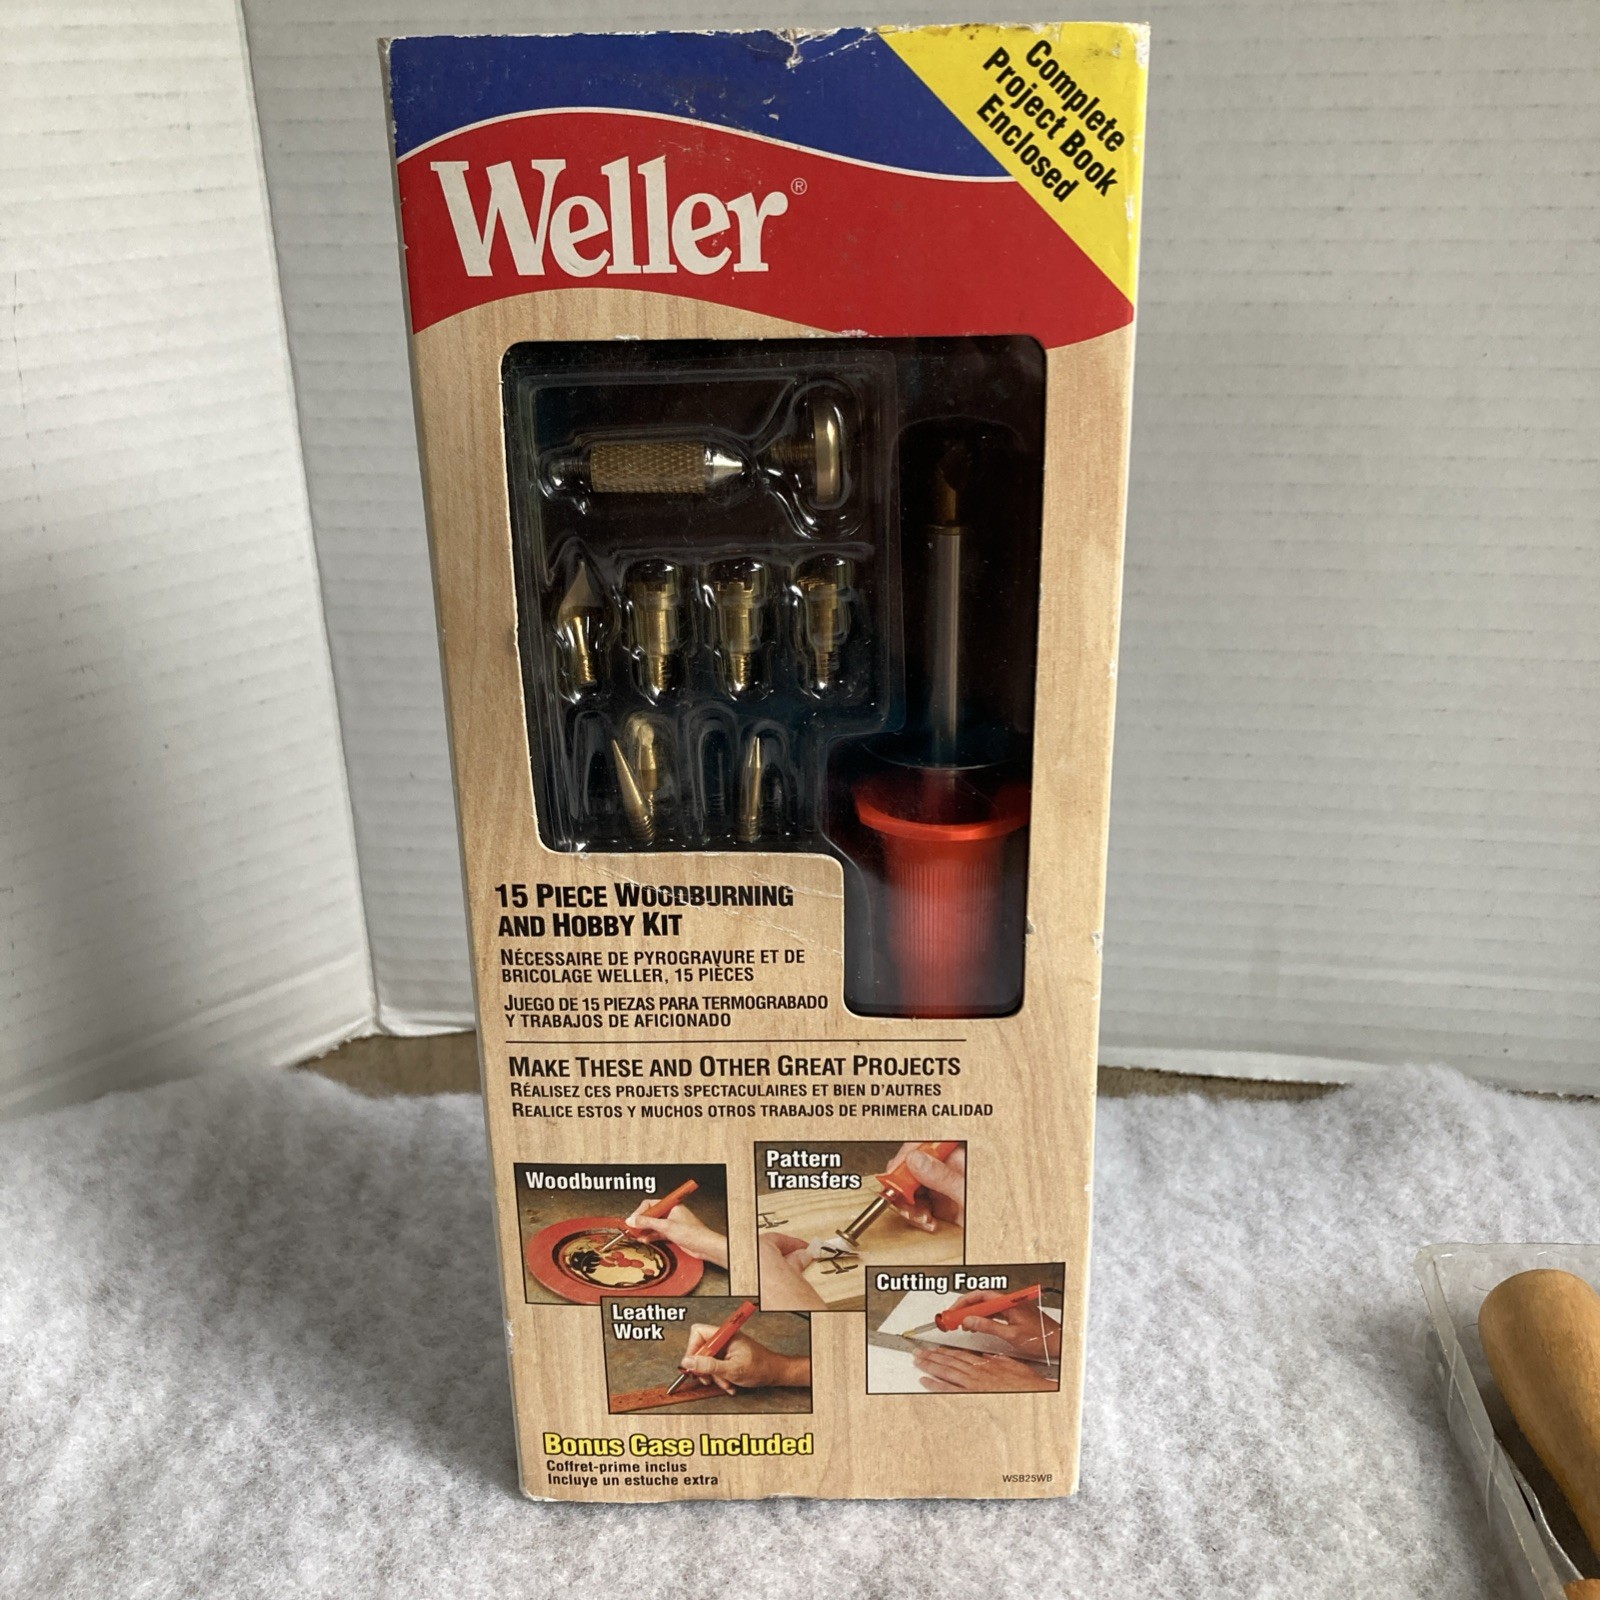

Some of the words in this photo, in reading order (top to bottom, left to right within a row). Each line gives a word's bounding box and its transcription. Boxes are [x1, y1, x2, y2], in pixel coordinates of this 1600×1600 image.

[1026, 40, 1125, 152] Complete
[983, 46, 1068, 140] Project
[1059, 129, 1118, 197] Book
[977, 93, 1079, 202] Enclosed
[430, 155, 788, 278] Weller
[495, 884, 528, 908] 15
[537, 884, 608, 908] PIECE
[615, 883, 794, 908] WOODBURNING
[498, 915, 545, 937] AND
[553, 913, 635, 937] HOBBY
[643, 912, 682, 935] KIT
[501, 948, 602, 966] NÉCESSAIRE
[608, 952, 627, 965] DE
[634, 950, 754, 965] PYROGRAVURE
[761, 950, 778, 963] ET
[785, 950, 805, 963] DE
[502, 969, 592, 983] BRICOLAGE
[598, 968, 669, 984] WELLER,
[675, 969, 693, 982] 15
[699, 963, 754, 982] PIÈCES
[504, 995, 554, 1011] JUEGO
[559, 997, 578, 1011] DE
[582, 997, 600, 1010] 15
[604, 997, 655, 1011] PIEZAS
[659, 997, 699, 1010] PARA
[702, 995, 828, 1010] TERMOGRABADO
[506, 1014, 515, 1027] Y
[520, 1014, 603, 1028] TRABAJOS
[609, 1014, 628, 1027] DE
[634, 1013, 731, 1027] AFICIONADO
[509, 1057, 570, 1077] MAKE
[575, 1057, 643, 1077] THESE
[650, 1059, 692, 1076] AND
[699, 1056, 770, 1076] OTHER
[778, 1055, 846, 1076] GREAT
[853, 1055, 961, 1076] PROJECTS
[511, 1082, 579, 1098] RÉALISEZ
[585, 1085, 611, 1098] CES
[616, 1085, 679, 1098] PROJETS
[684, 1084, 807, 1097] SPECTACULAIRES
[812, 1085, 828, 1096] ET
[834, 1085, 865, 1096] BIEN
[512, 1103, 573, 1118] REALICE
[578, 1105, 623, 1118] ESTOS
[627, 1105, 636, 1118] Y
[641, 1105, 703, 1118] MUCHOS
[708, 1105, 756, 1117] OTROS
[760, 1105, 833, 1117] TRABAJOS
[840, 1105, 857, 1116] DE
[862, 1105, 927, 1116] PRIMERA
[932, 1104, 993, 1116] CALIDAD
[766, 1150, 841, 1168] Pattern
[525, 1172, 656, 1193] Woodburning
[766, 1171, 862, 1190] Transfers
[876, 1274, 948, 1292] Cutting
[955, 1274, 1007, 1289] Foam
[612, 1304, 686, 1321] Leather
[613, 1324, 664, 1340] Work
[543, 1432, 624, 1456] Bonus
[629, 1433, 694, 1456] Case
[700, 1433, 814, 1456] Included
[547, 1460, 640, 1474] Coffret-prime
[645, 1461, 687, 1472] inclus
[548, 1474, 597, 1487] Incluye
[603, 1477, 619, 1486] un
[624, 1475, 678, 1485] estuche
[684, 1476, 718, 1485] extra
[1002, 1474, 1052, 1482] WSB25WB
